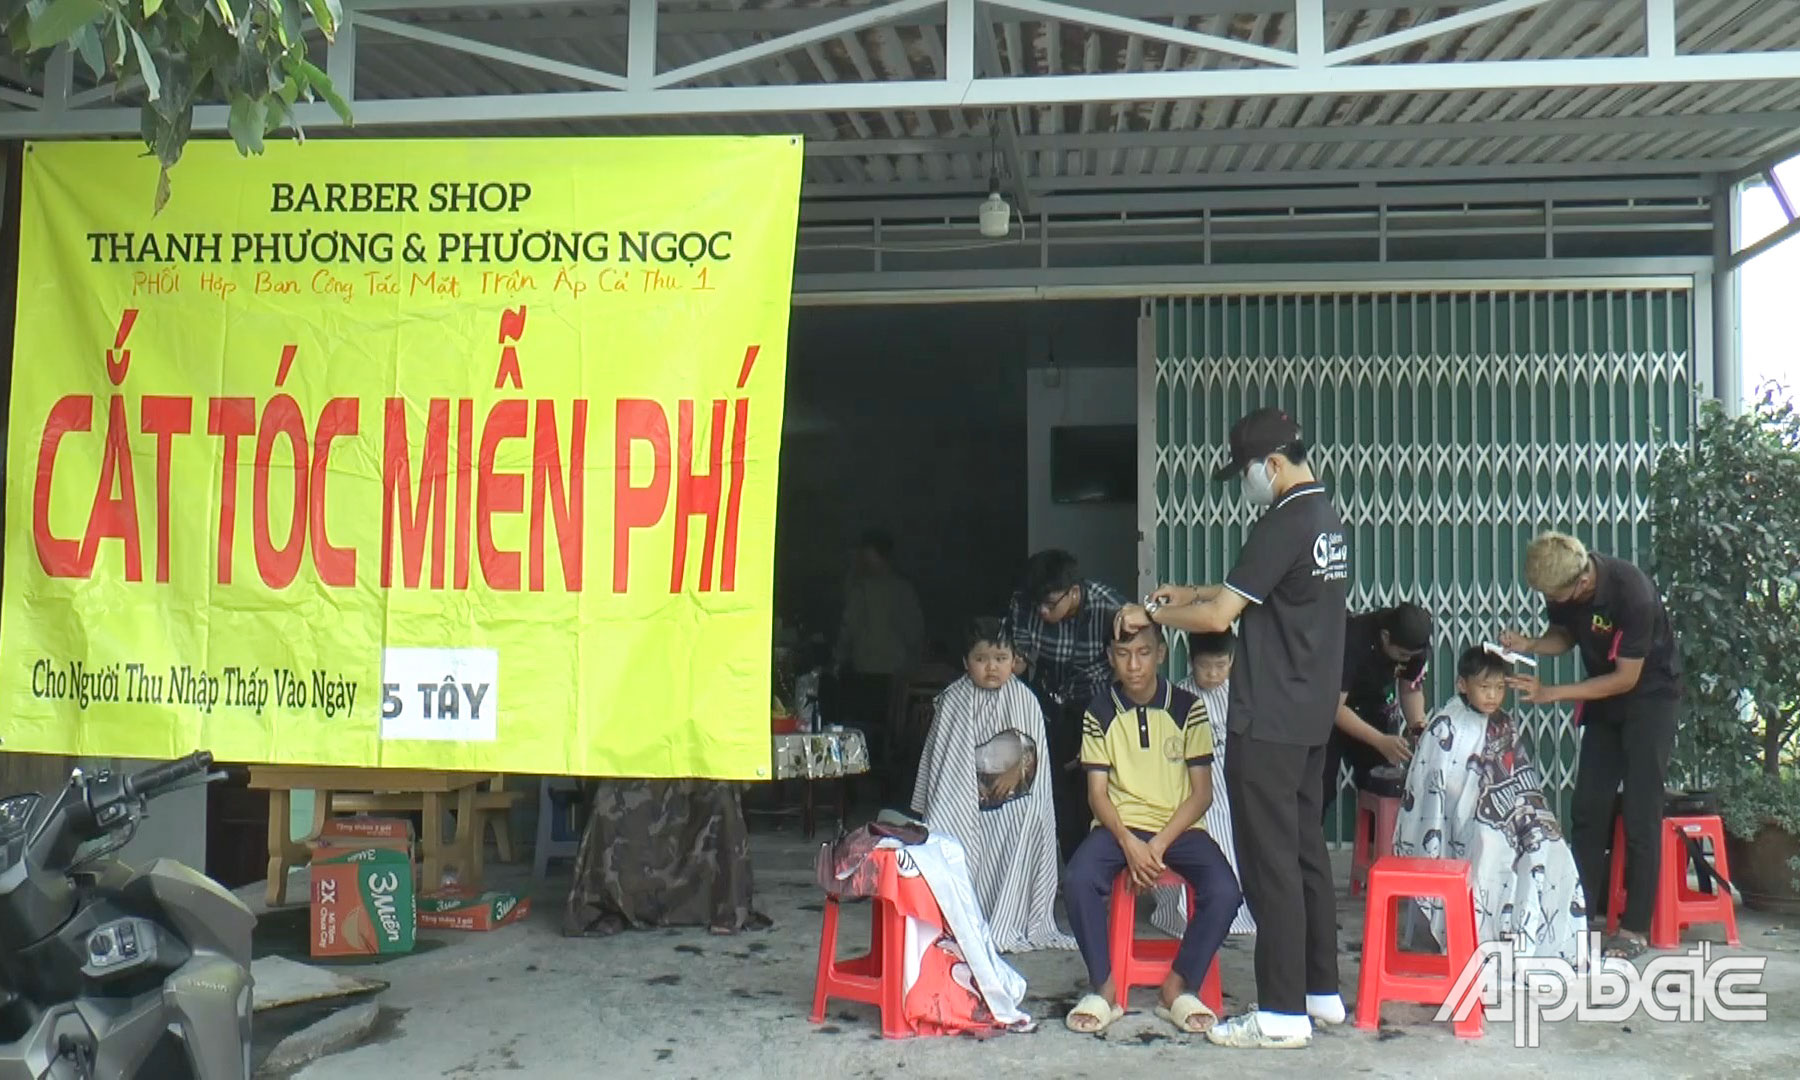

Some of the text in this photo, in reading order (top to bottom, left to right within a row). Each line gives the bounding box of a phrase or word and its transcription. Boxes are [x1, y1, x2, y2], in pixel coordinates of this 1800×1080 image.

[271, 183, 532, 212] BARBER SHOP
[87, 229, 732, 268] THANH PHƯƠNG & PHƯƠNG NGỌC
[254, 271, 301, 294] Ban
[364, 271, 401, 296] Tác
[692, 267, 716, 290] 1
[33, 305, 760, 594] CẮT TÓC MIỄN PHÍ
[33, 659, 357, 718] Cho Người Thu Nhập Thấp Vào Ngày
[382, 675, 489, 719] 5 TÂY
